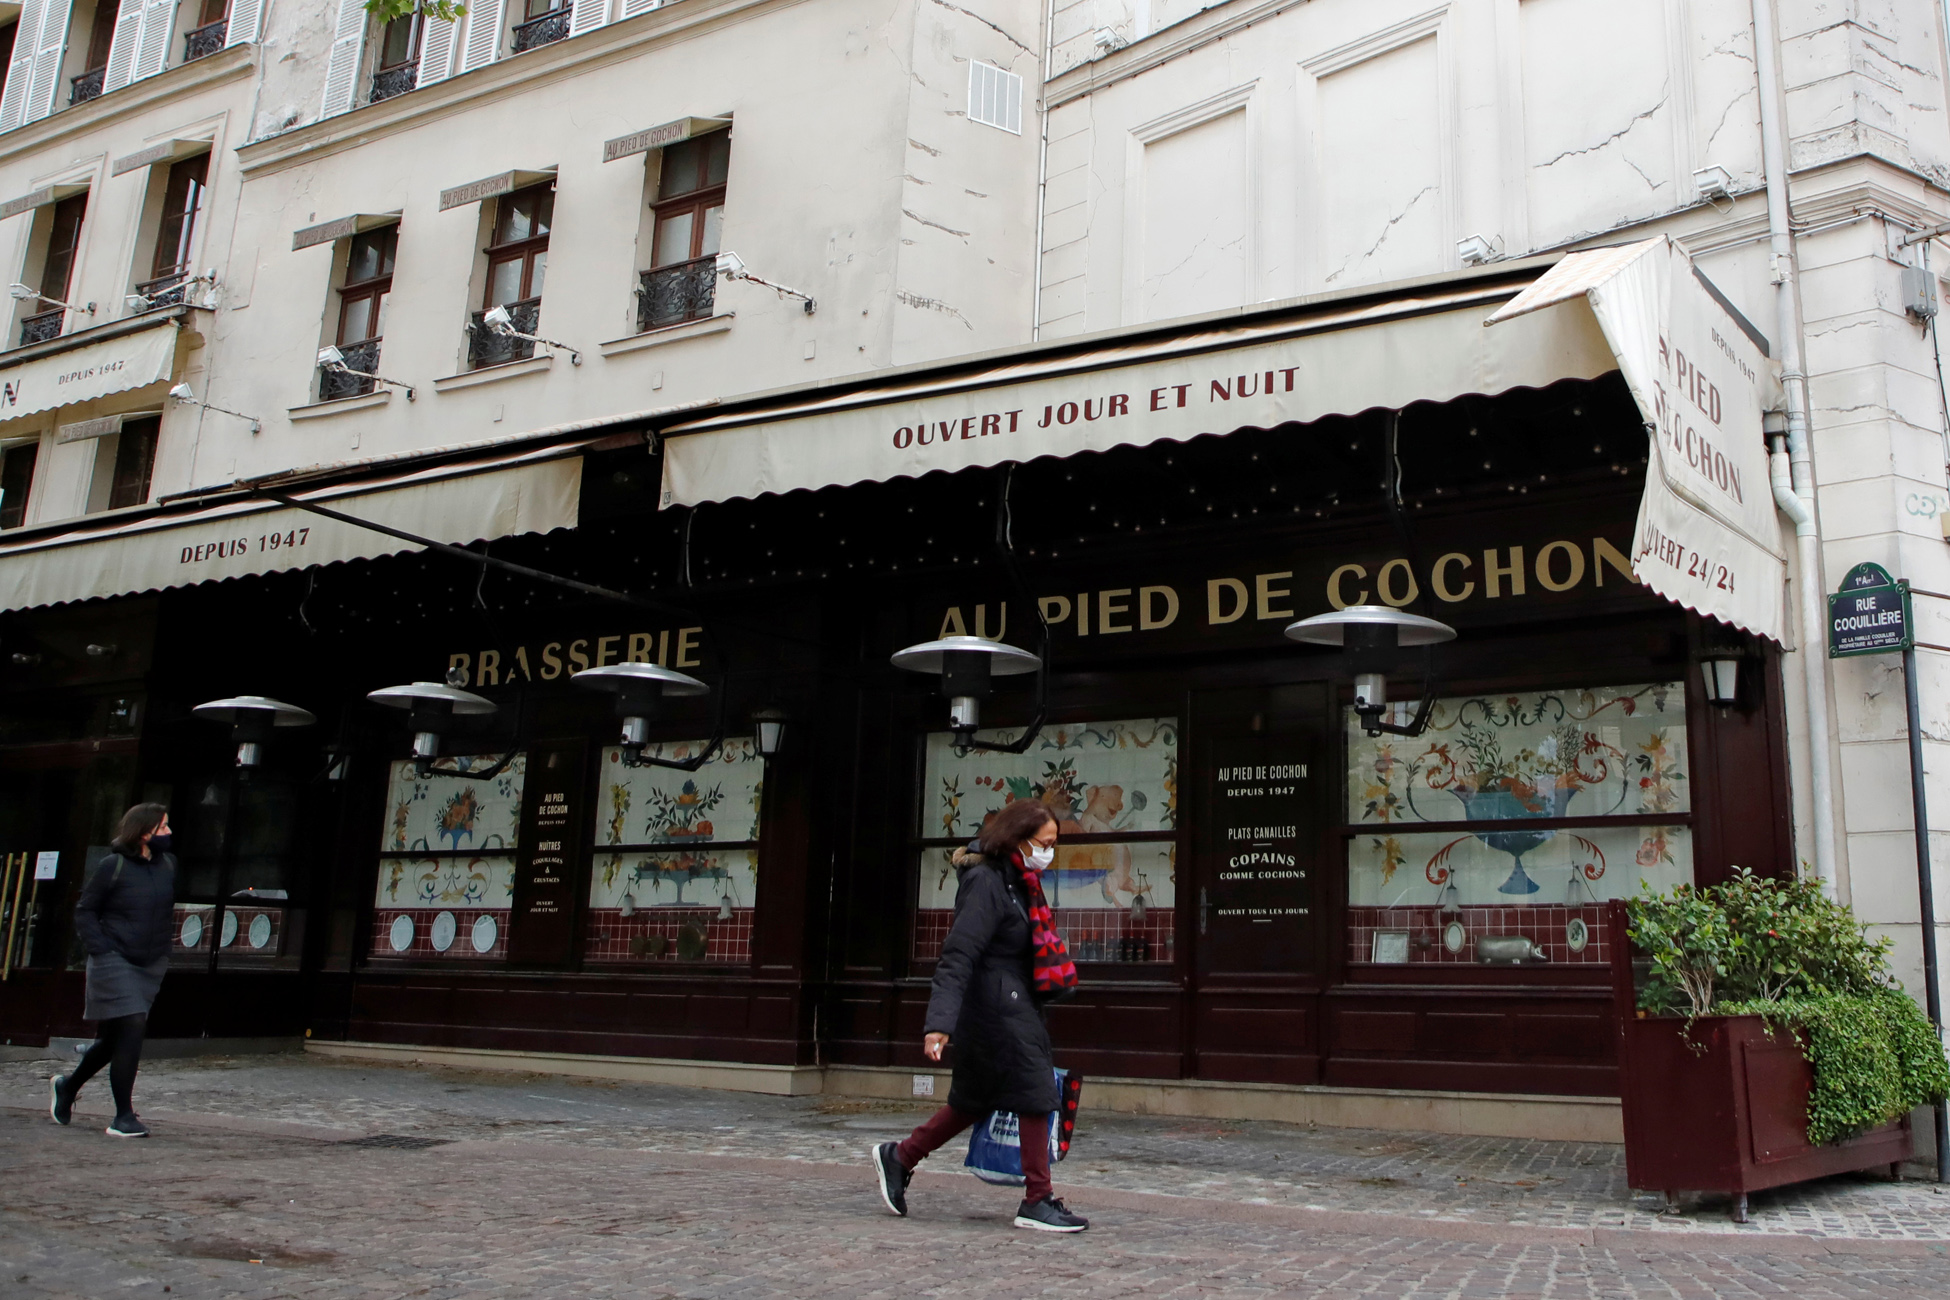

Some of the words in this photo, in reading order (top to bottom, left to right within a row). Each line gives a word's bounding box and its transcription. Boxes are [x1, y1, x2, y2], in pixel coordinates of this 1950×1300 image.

[607, 142, 618, 157] AU
[620, 137, 638, 152] PIED
[639, 133, 650, 147] DE
[650, 123, 684, 143] COCHON
[442, 192, 452, 206] AU
[453, 188, 469, 203] PIED
[470, 184, 480, 198] DE
[480, 175, 509, 195] COCHON
[1711, 327, 1736, 365] DEPUIS
[1738, 358, 1755, 385] 1947
[58, 368, 94, 385] DEPUIS
[99, 360, 125, 376] 1947
[1675, 348, 1721, 425] PIED
[892, 409, 1023, 450] OUVERT
[1037, 393, 1130, 428] JOUR
[1149, 383, 1193, 412] ET
[1210, 366, 1300, 403] NUIT
[180, 537, 248, 564] DEPUIS
[259, 527, 310, 552] 1947
[1688, 552, 1735, 595] 24/24
[937, 601, 1007, 643] AU
[1038, 585, 1180, 637] PIED
[1207, 571, 1294, 625] DE
[1856, 597, 1876, 611] RUE
[1834, 609, 1902, 632] COQUILLIÈRE
[449, 626, 703, 687] BRASSERIE
[1218, 768, 1230, 781] AU
[1232, 767, 1252, 781] PIED
[1255, 766, 1267, 780] DE
[1269, 764, 1307, 779] COCHON
[544, 793, 552, 803] AU
[552, 793, 565, 803] PIED
[1227, 788, 1264, 796] DEPUIS
[1268, 786, 1295, 795] 1947
[539, 805, 546, 815] DE
[547, 805, 568, 815] COCHON
[1228, 827, 1251, 840] PLATS
[1254, 825, 1296, 839] CANAILLES
[1229, 853, 1296, 868] COPAINS
[1219, 871, 1255, 880] COMME
[1258, 870, 1306, 879] COCHONS
